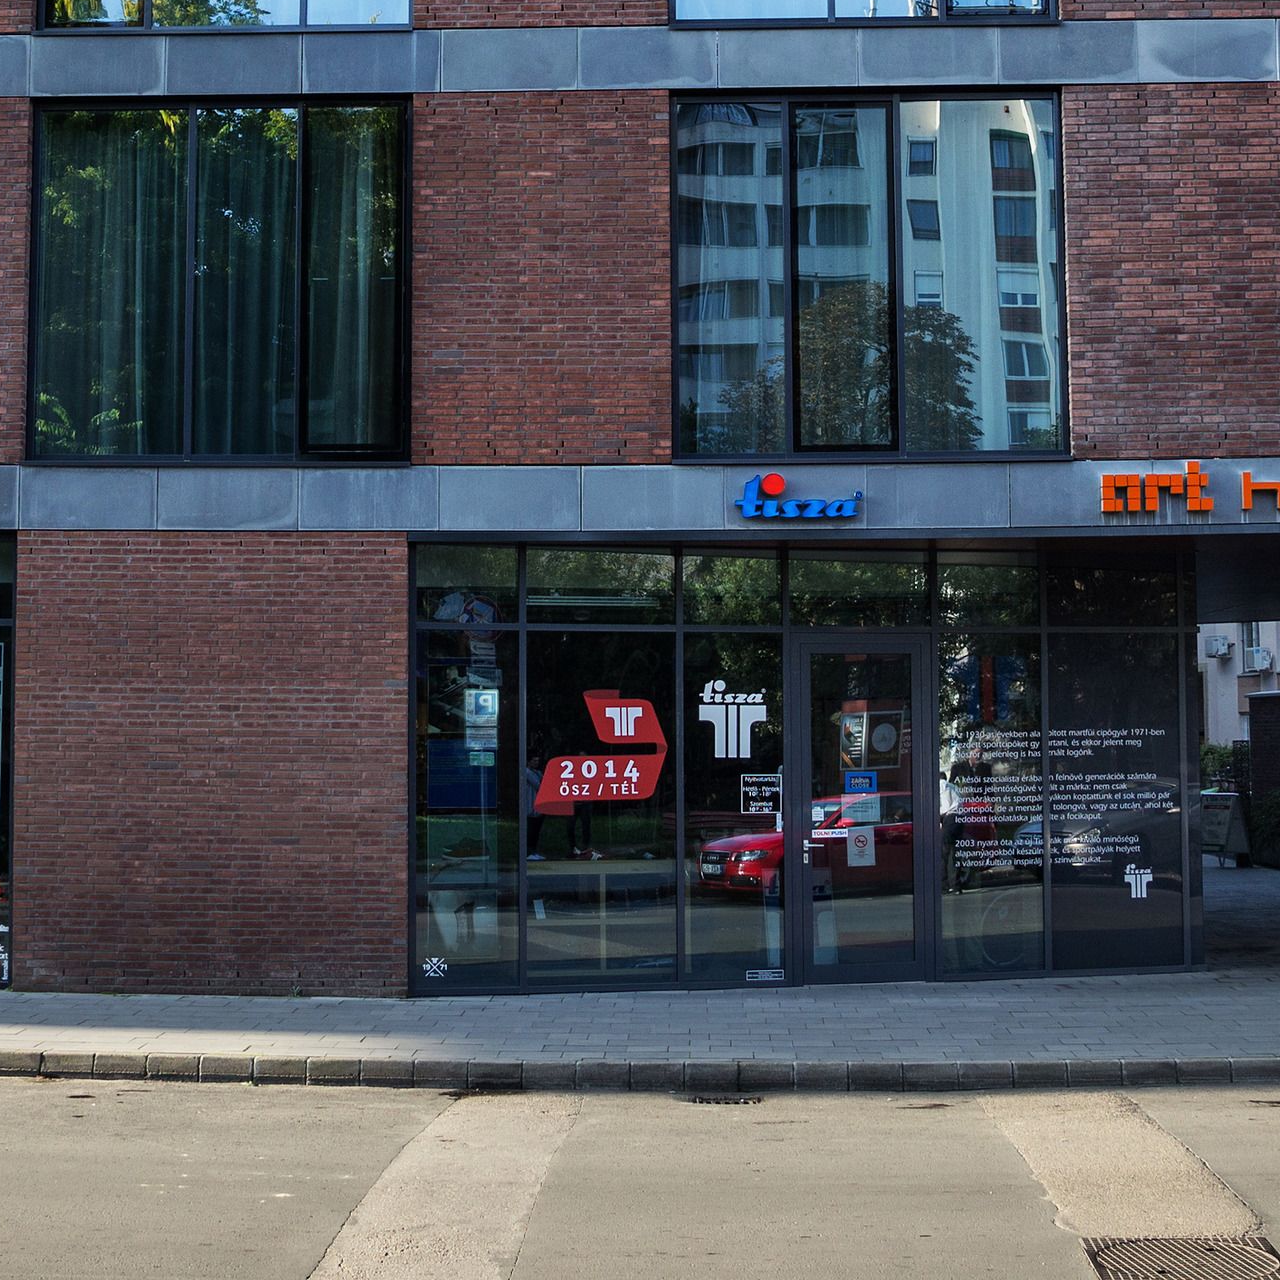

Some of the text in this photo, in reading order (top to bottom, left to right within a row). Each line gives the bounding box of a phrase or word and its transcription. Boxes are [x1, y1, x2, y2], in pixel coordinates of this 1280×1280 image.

[1101, 461, 1214, 512] art
[735, 473, 859, 519] tisza
[699, 680, 764, 703] tisza
[1131, 728, 1165, 736] 1971-ben
[1071, 738, 1079, 746] és
[1081, 738, 1101, 746] ekkor
[1102, 738, 1124, 748] jelent
[989, 750, 1019, 760] jelenleg
[560, 760, 640, 782] 2014
[954, 776, 961, 784] A
[983, 775, 1020, 784] szocialista
[1085, 772, 1125, 782] generációk
[1127, 772, 1157, 780] számára
[559, 781, 639, 796] ŐSZ / TÉL
[1111, 782, 1128, 790] csak
[1137, 791, 1157, 799] millió
[1158, 791, 1171, 800] pár
[1090, 802, 1108, 811] vagy
[1144, 801, 1161, 809] ahol
[955, 815, 987, 823] ledobott
[955, 839, 975, 848] 2003
[977, 840, 998, 848] nyara
[1102, 834, 1139, 844] minőségű
[955, 848, 1015, 858] alapanyagokból
[1115, 844, 1141, 854] helyett
